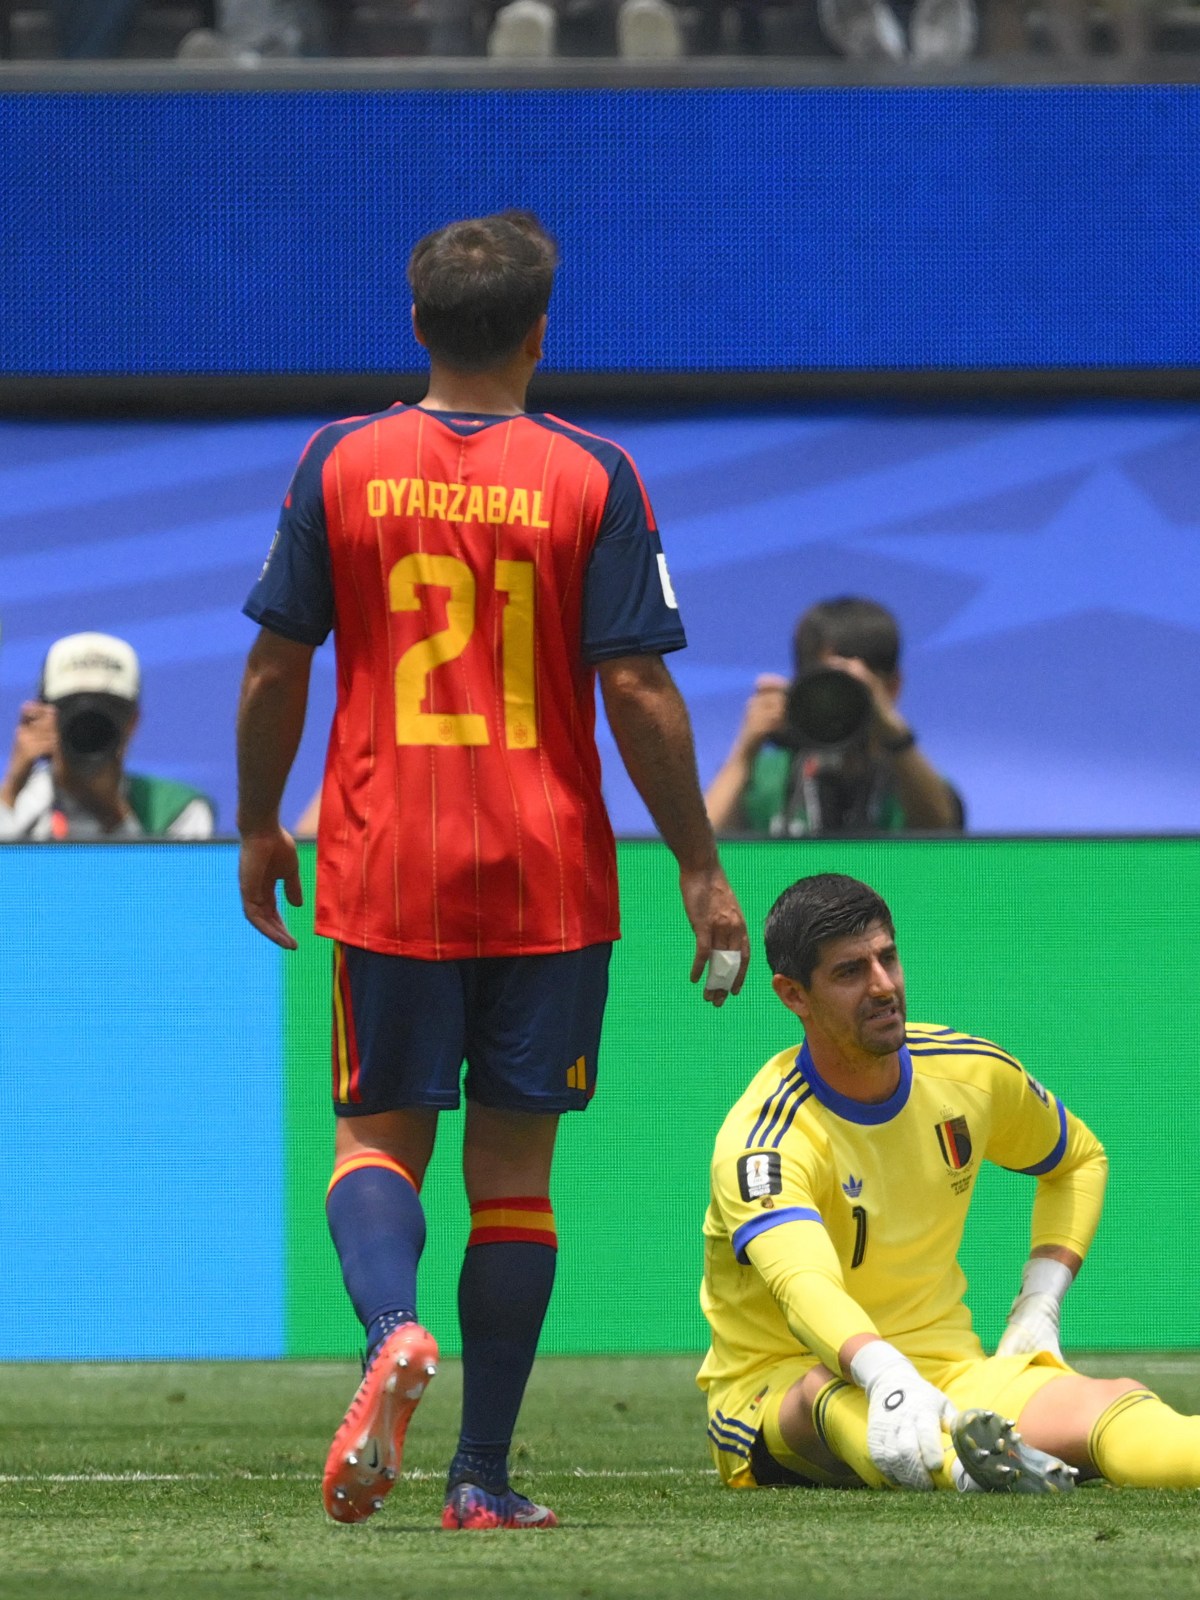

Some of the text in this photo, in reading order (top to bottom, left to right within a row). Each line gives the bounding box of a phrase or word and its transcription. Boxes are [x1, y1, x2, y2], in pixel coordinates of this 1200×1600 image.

[366, 478, 550, 528] OYARZABAL
[388, 552, 537, 749] 21
[851, 1205, 867, 1269] 1
